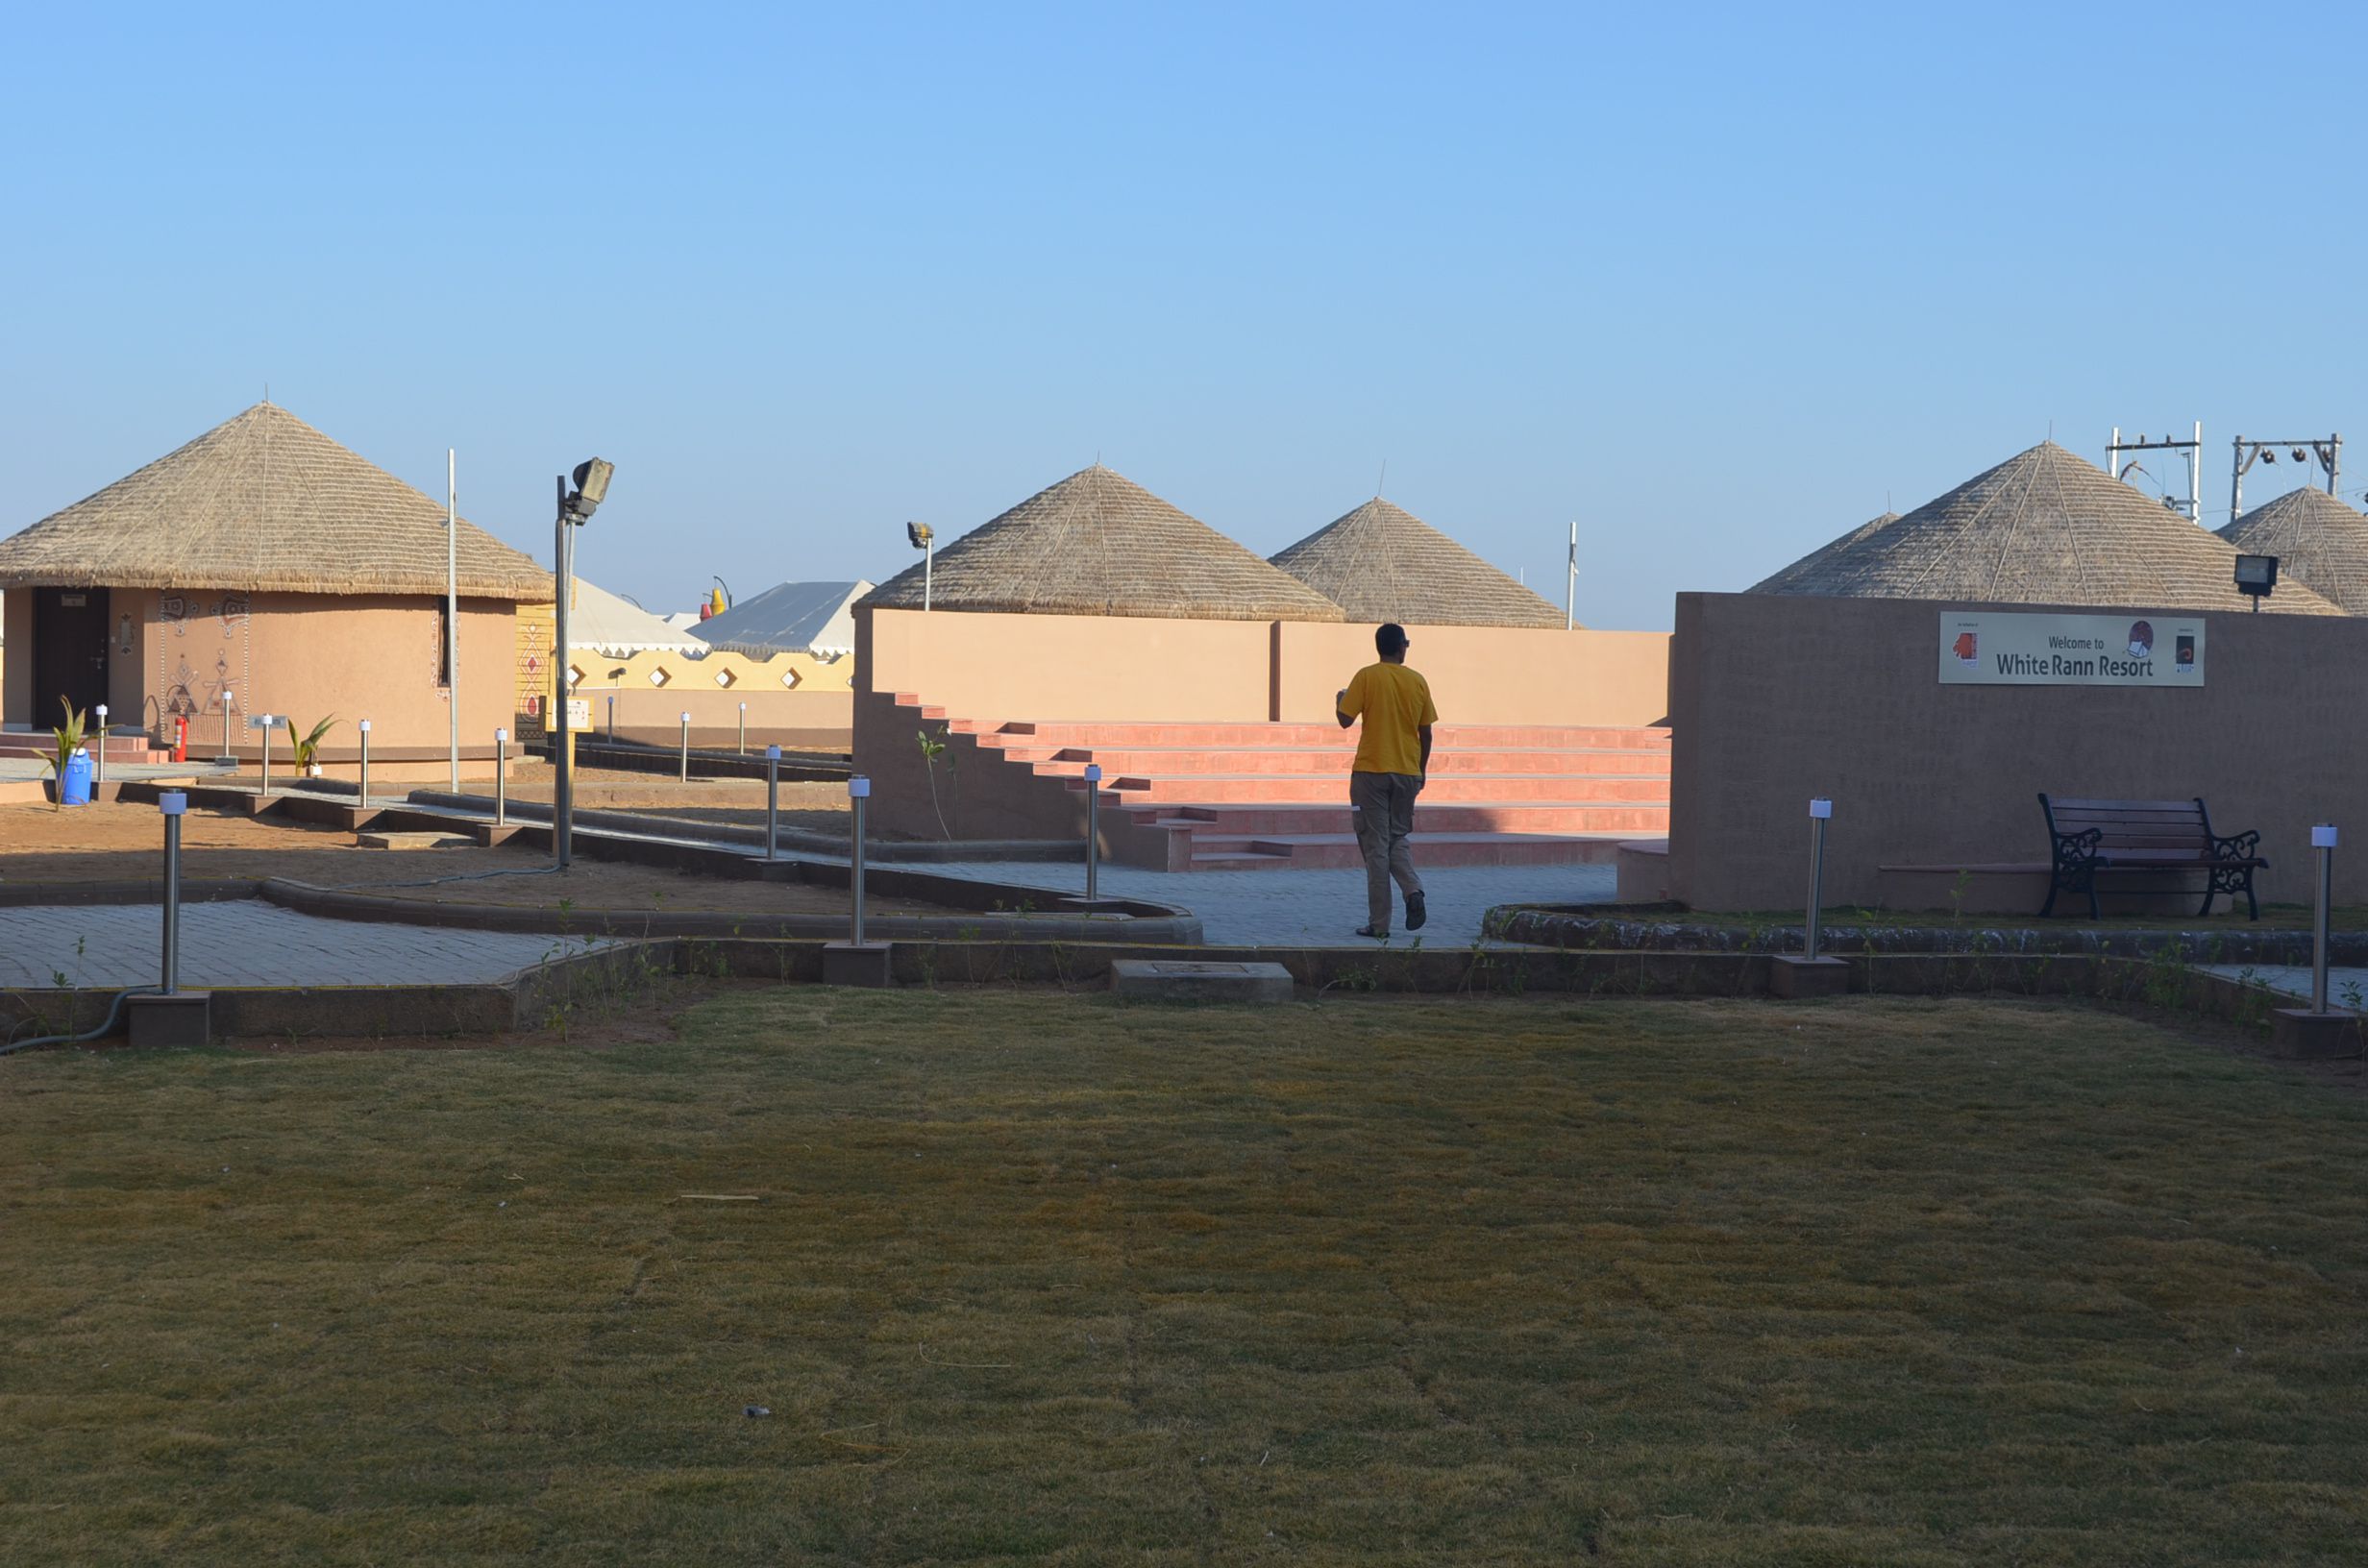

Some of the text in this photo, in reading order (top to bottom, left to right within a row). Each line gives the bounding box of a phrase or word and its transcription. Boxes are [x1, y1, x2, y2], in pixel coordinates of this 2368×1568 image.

[2048, 636, 2105, 650] Welcome to
[1996, 653, 2154, 677] White Rann Resort
